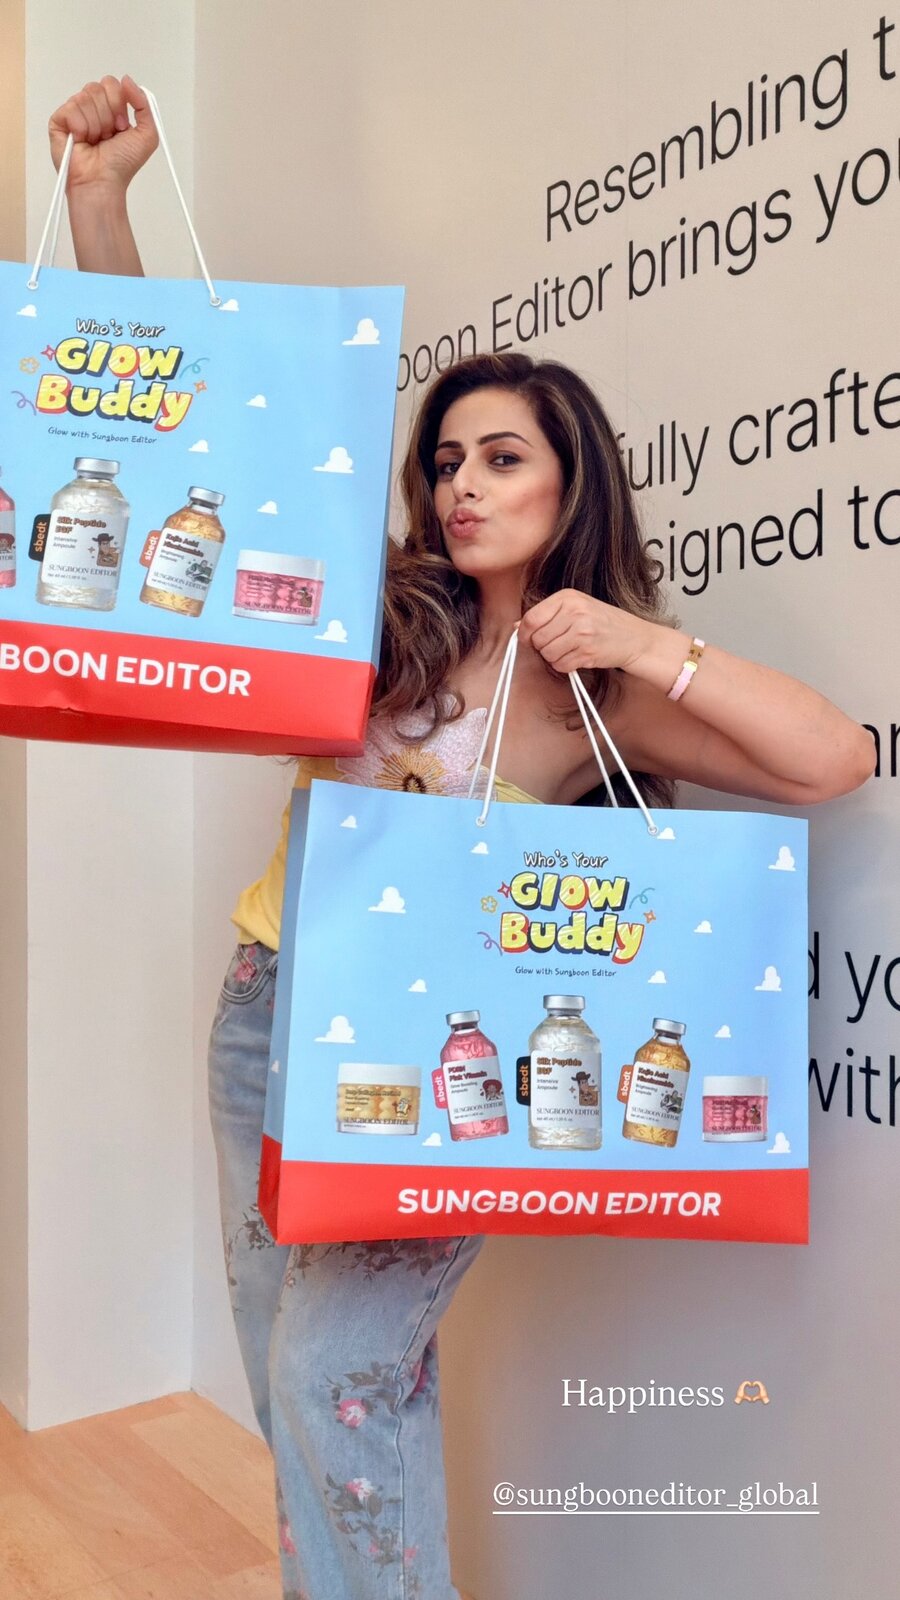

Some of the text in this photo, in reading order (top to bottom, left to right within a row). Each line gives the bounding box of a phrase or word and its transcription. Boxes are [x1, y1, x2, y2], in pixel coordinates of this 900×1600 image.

[546, 48, 848, 242] Resembling
[492, 261, 613, 353] Editor
[628, 189, 792, 299] brings
[814, 138, 900, 243] yo
[76, 318, 165, 338] Who's Your
[35, 374, 193, 432] Buddy
[48, 427, 157, 444] Glow with Sungboon Editor
[33, 521, 47, 552] sbedt
[0, 643, 251, 697] BOON EDITOR
[523, 849, 609, 868] Who's Your
[500, 911, 645, 964] Buddy
[515, 965, 617, 978] Glow with Sungboon Editor
[434, 1076, 446, 1103] sbedt
[519, 1064, 529, 1097] sbedt
[621, 1071, 631, 1096] sbedt
[397, 1188, 721, 1217] SUNGBOON EDITOR
